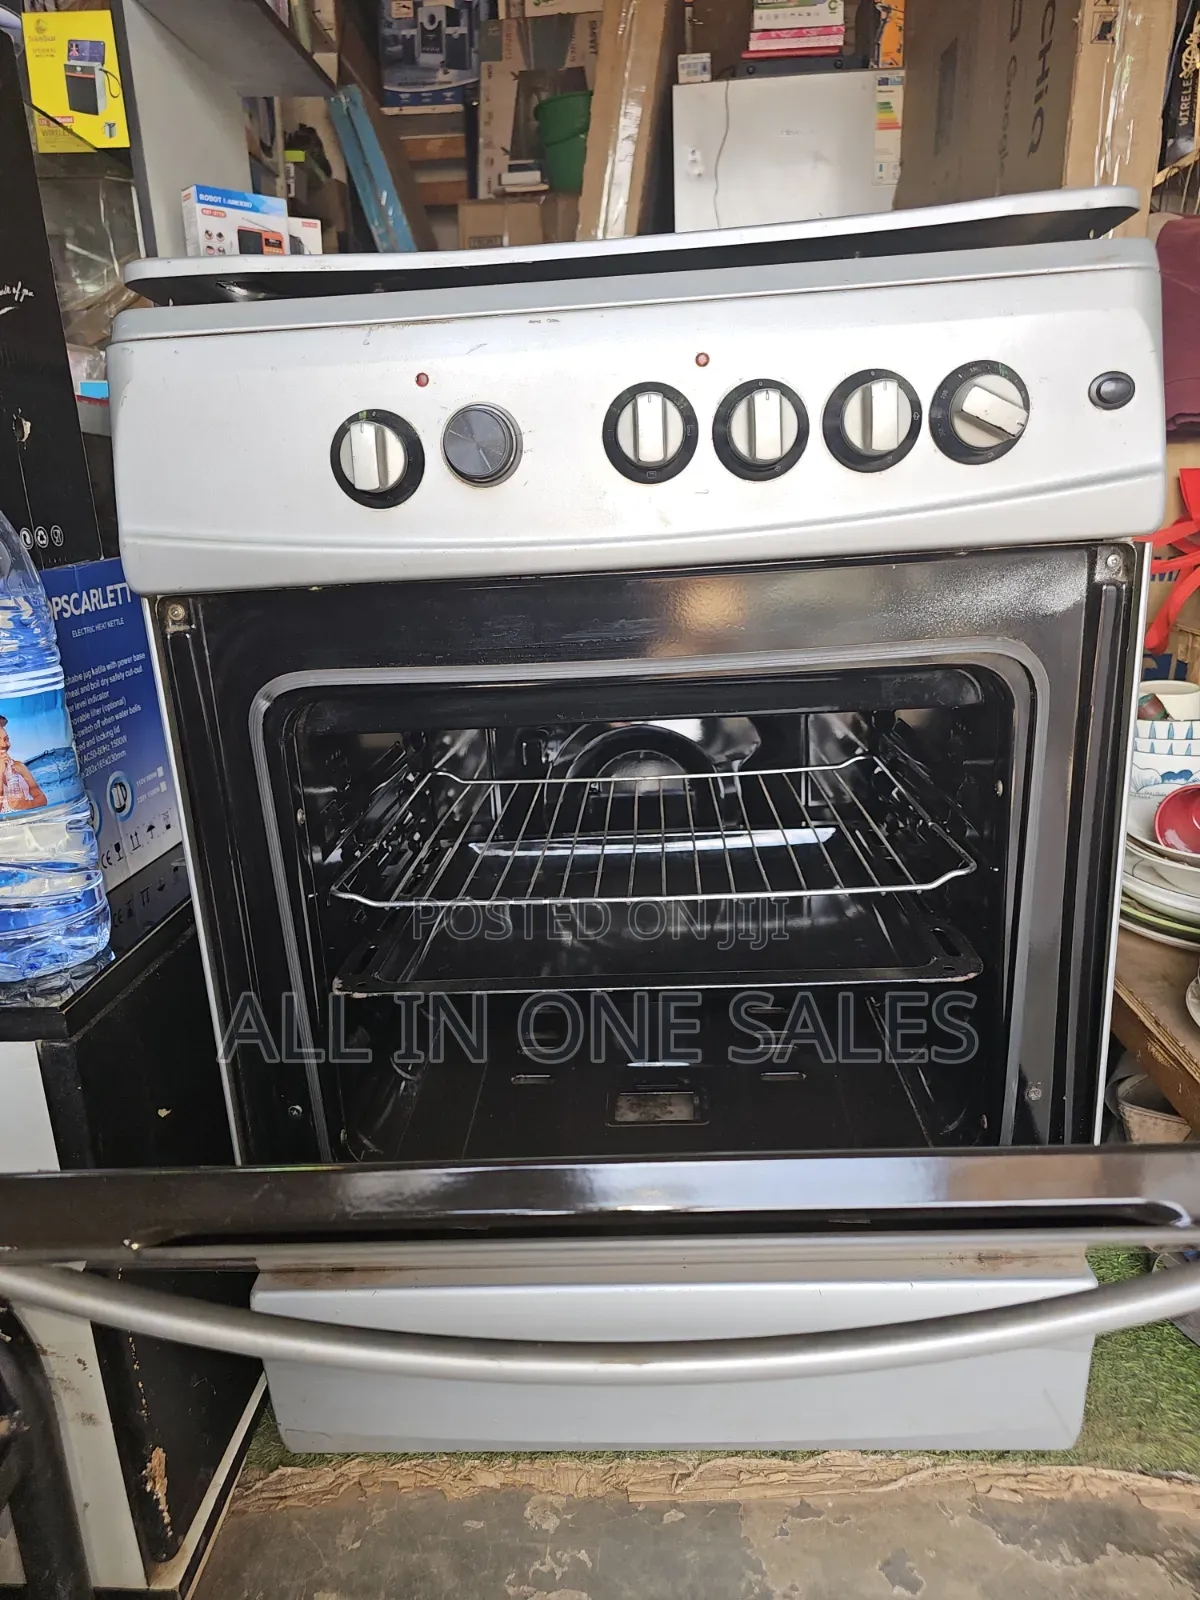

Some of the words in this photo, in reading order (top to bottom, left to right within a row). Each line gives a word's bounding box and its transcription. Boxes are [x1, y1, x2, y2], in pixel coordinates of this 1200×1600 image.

[1178, 68, 1193, 127] WIRELES
[71, 625, 96, 638] ELECTRIC
[95, 621, 108, 631] HEAT
[107, 617, 125, 629] KETTLE
[106, 660, 118, 671] with
[117, 656, 133, 669] power
[133, 652, 146, 662] base
[66, 688, 80, 700] heat
[80, 683, 90, 695] and
[100, 677, 109, 687] dry
[109, 671, 125, 683] safety
[74, 698, 88, 711] level
[87, 690, 110, 705] indicator
[101, 696, 127, 714] (optional)
[73, 723, 94, 740] o-switch
[100, 715, 115, 727] when
[114, 709, 129, 721] water
[86, 736, 96, 748] and
[81, 750, 127, 779] e:203x165x230mm
